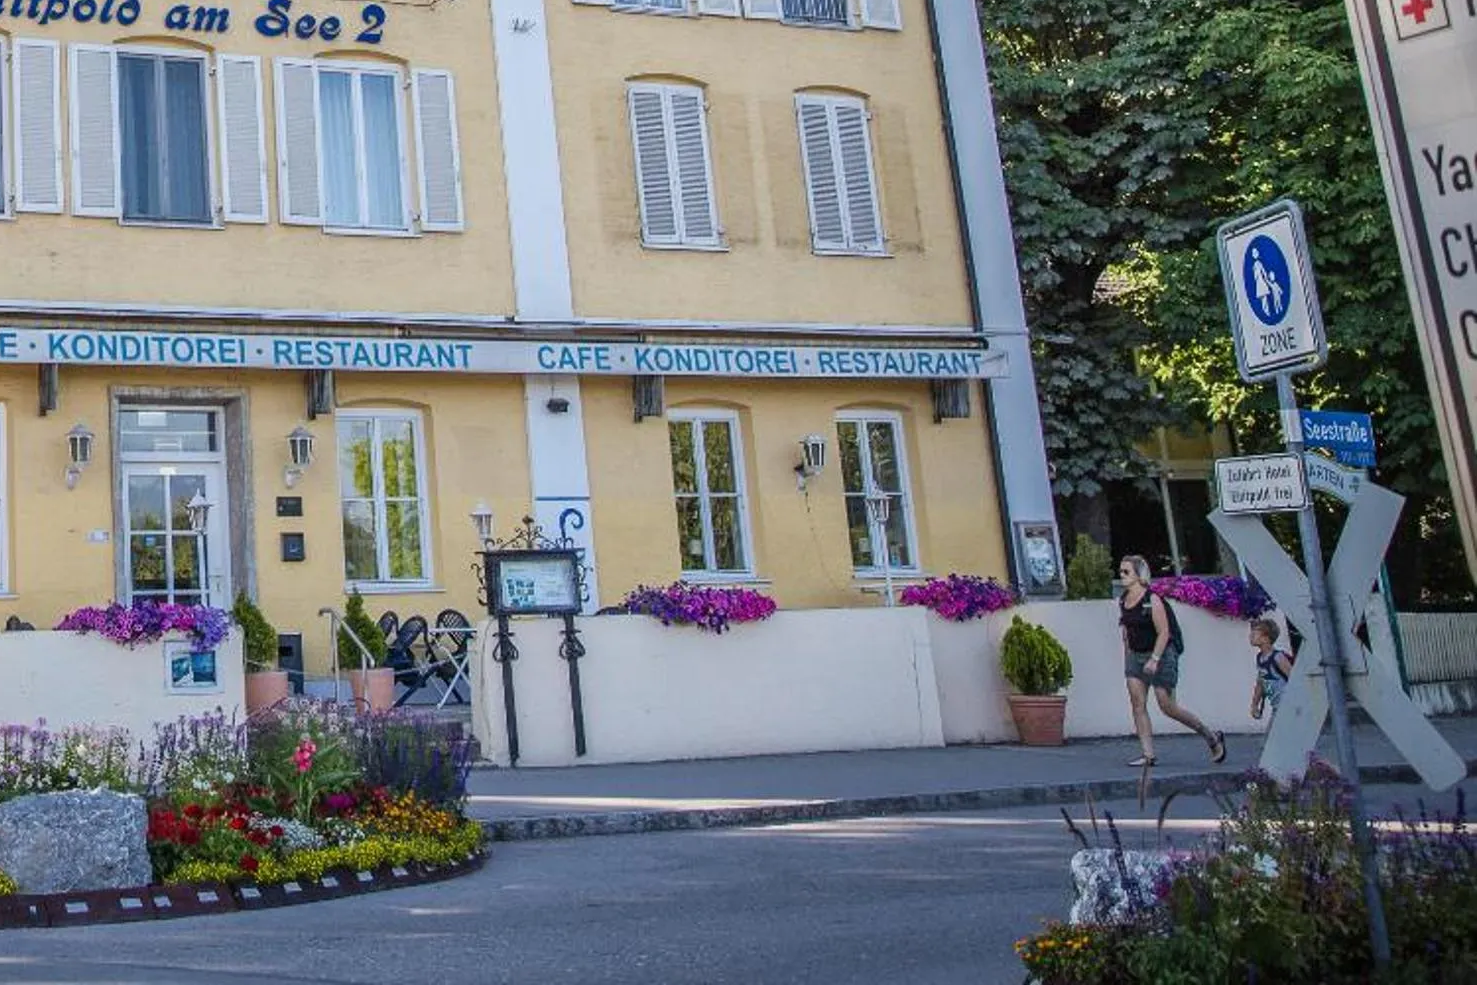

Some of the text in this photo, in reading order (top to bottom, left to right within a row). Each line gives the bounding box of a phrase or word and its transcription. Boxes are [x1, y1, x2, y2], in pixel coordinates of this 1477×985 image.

[165, 4, 230, 33] am
[355, 3, 387, 45] 2
[1421, 143, 1477, 196] Ya
[47, 333, 247, 364] KONDITOREI
[273, 339, 472, 368] RESTAURANT
[1259, 326, 1298, 357] ZONE
[537, 346, 982, 375] CAFE KONDITOREI RESTAURANT
[1303, 417, 1368, 443] Seestraße
[1308, 463, 1344, 490] ARTEN
